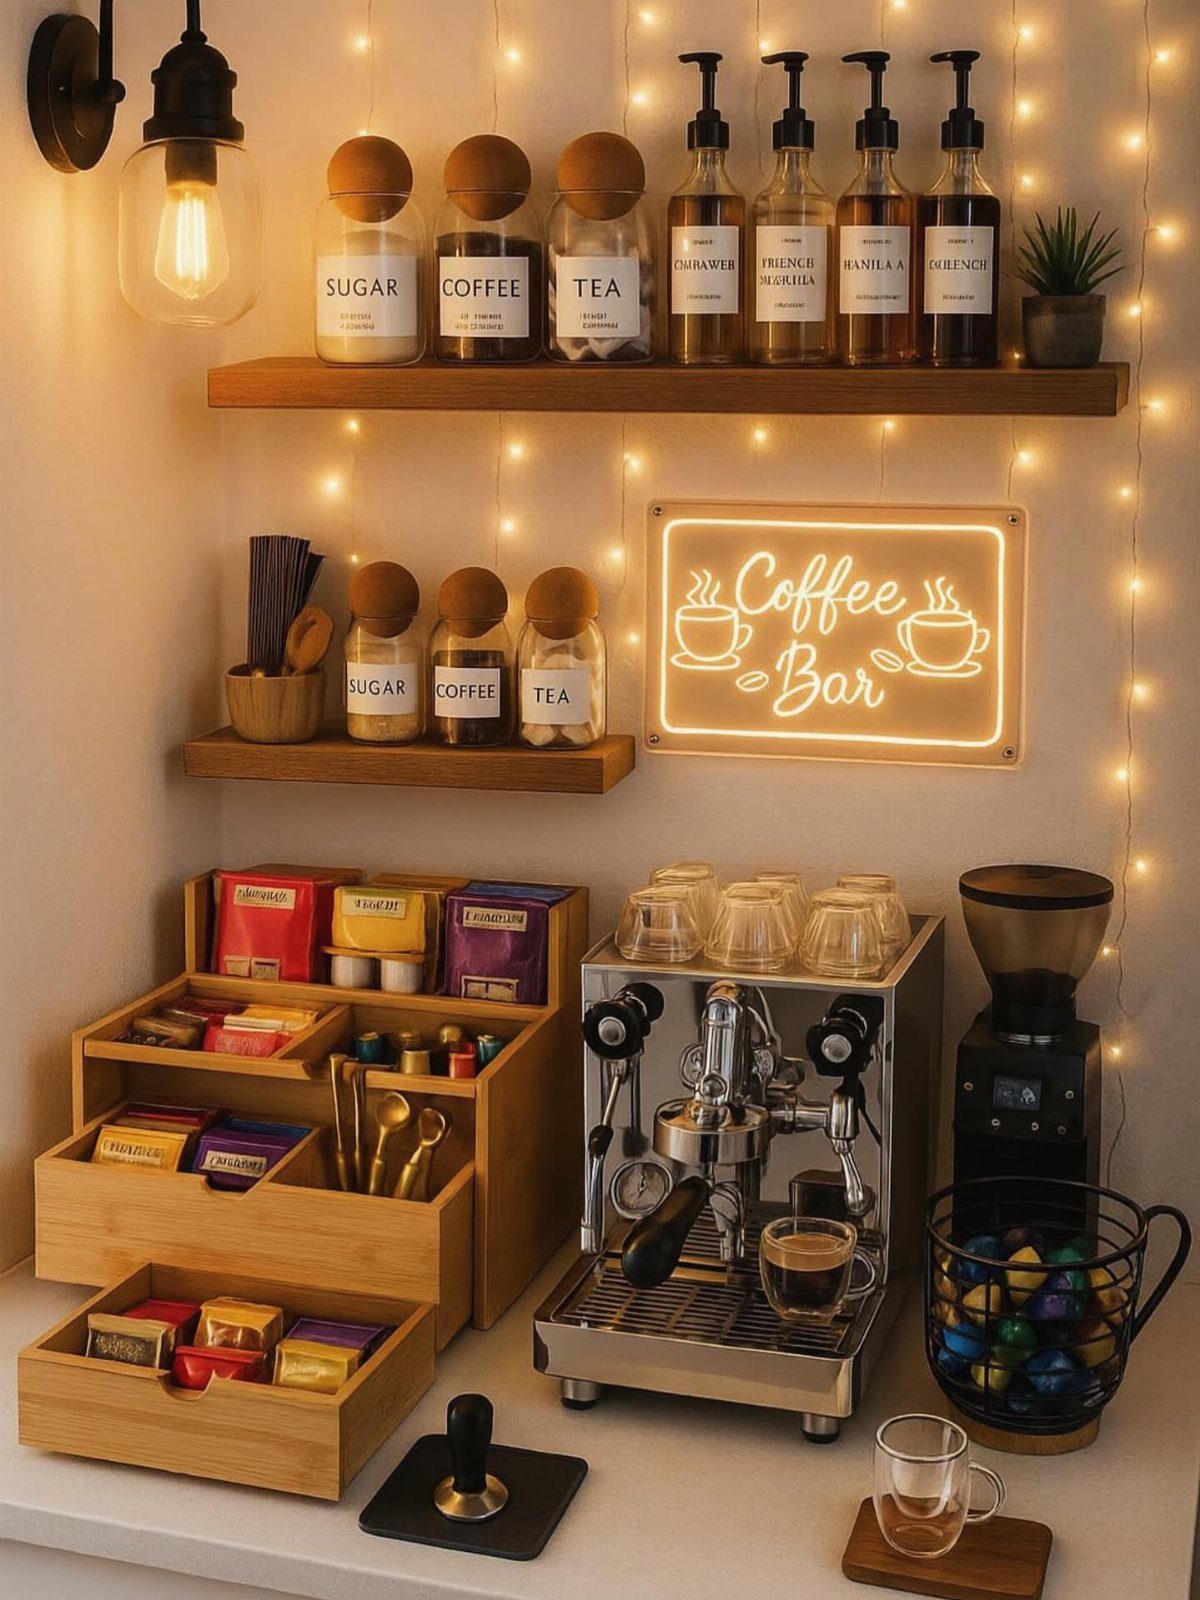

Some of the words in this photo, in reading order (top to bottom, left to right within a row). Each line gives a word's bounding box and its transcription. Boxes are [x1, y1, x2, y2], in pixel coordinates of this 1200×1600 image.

[326, 277, 399, 297] SUGAR
[442, 277, 521, 298] COFFEE
[572, 277, 622, 298] TEA
[735, 551, 907, 636] Coffee
[349, 679, 406, 695] SUGAR
[772, 640, 884, 718] Bar
[436, 683, 496, 700] COFFEE
[533, 687, 571, 705] TEA
